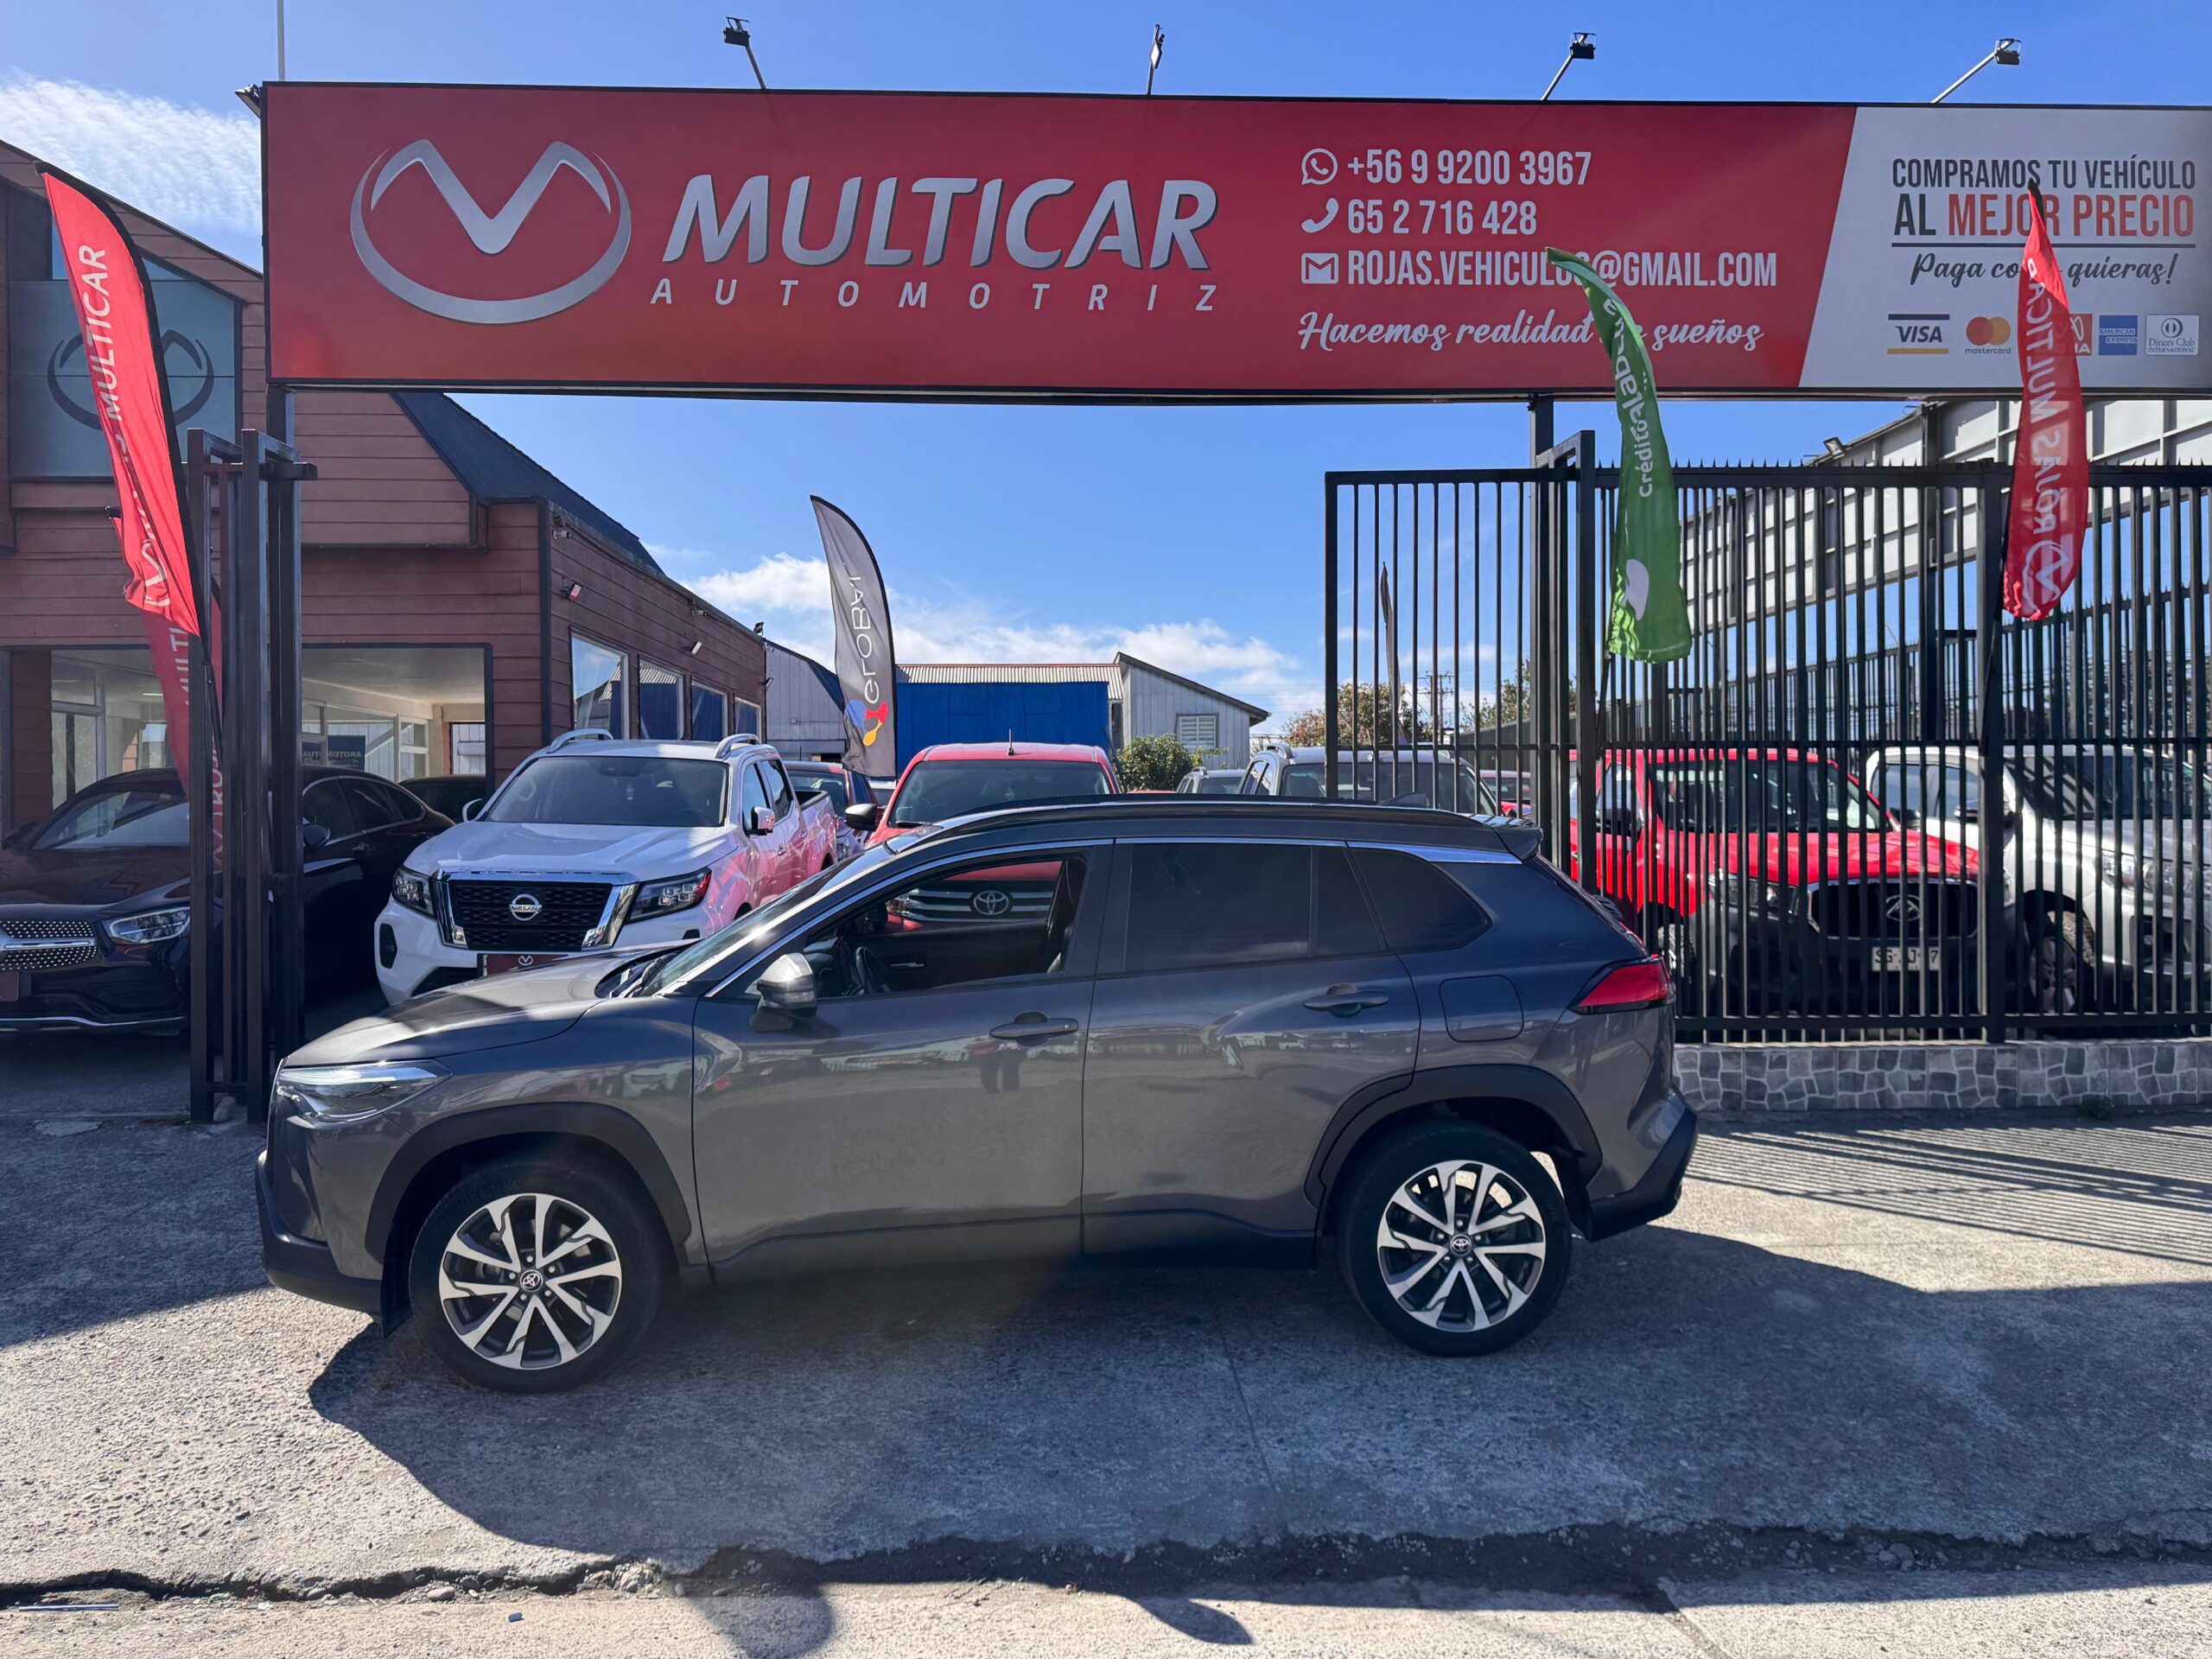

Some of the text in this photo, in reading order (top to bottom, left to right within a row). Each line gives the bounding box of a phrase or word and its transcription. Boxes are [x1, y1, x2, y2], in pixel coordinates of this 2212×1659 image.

[1347, 149, 1592, 186] +56 9 9200 3967
[1891, 154, 2196, 189] COMPRAMOS TU VEHÍCULO
[662, 174, 1217, 270] MULTICAR
[1348, 199, 1537, 235] 65 2 716 428
[1894, 194, 2194, 238] AL MEJOR PRECIO
[1910, 252, 1986, 288] Paga
[2067, 253, 2179, 288] quieras!
[650, 277, 1217, 311] AUTOMOTRIZ
[78, 245, 123, 422] MULTICAR
[1298, 311, 1451, 352] Hacemos
[1455, 308, 1594, 345] realidad
[1650, 318, 1764, 352] sueños
[1894, 326, 1942, 343] VISA
[2149, 338, 2196, 346] Diners Club
